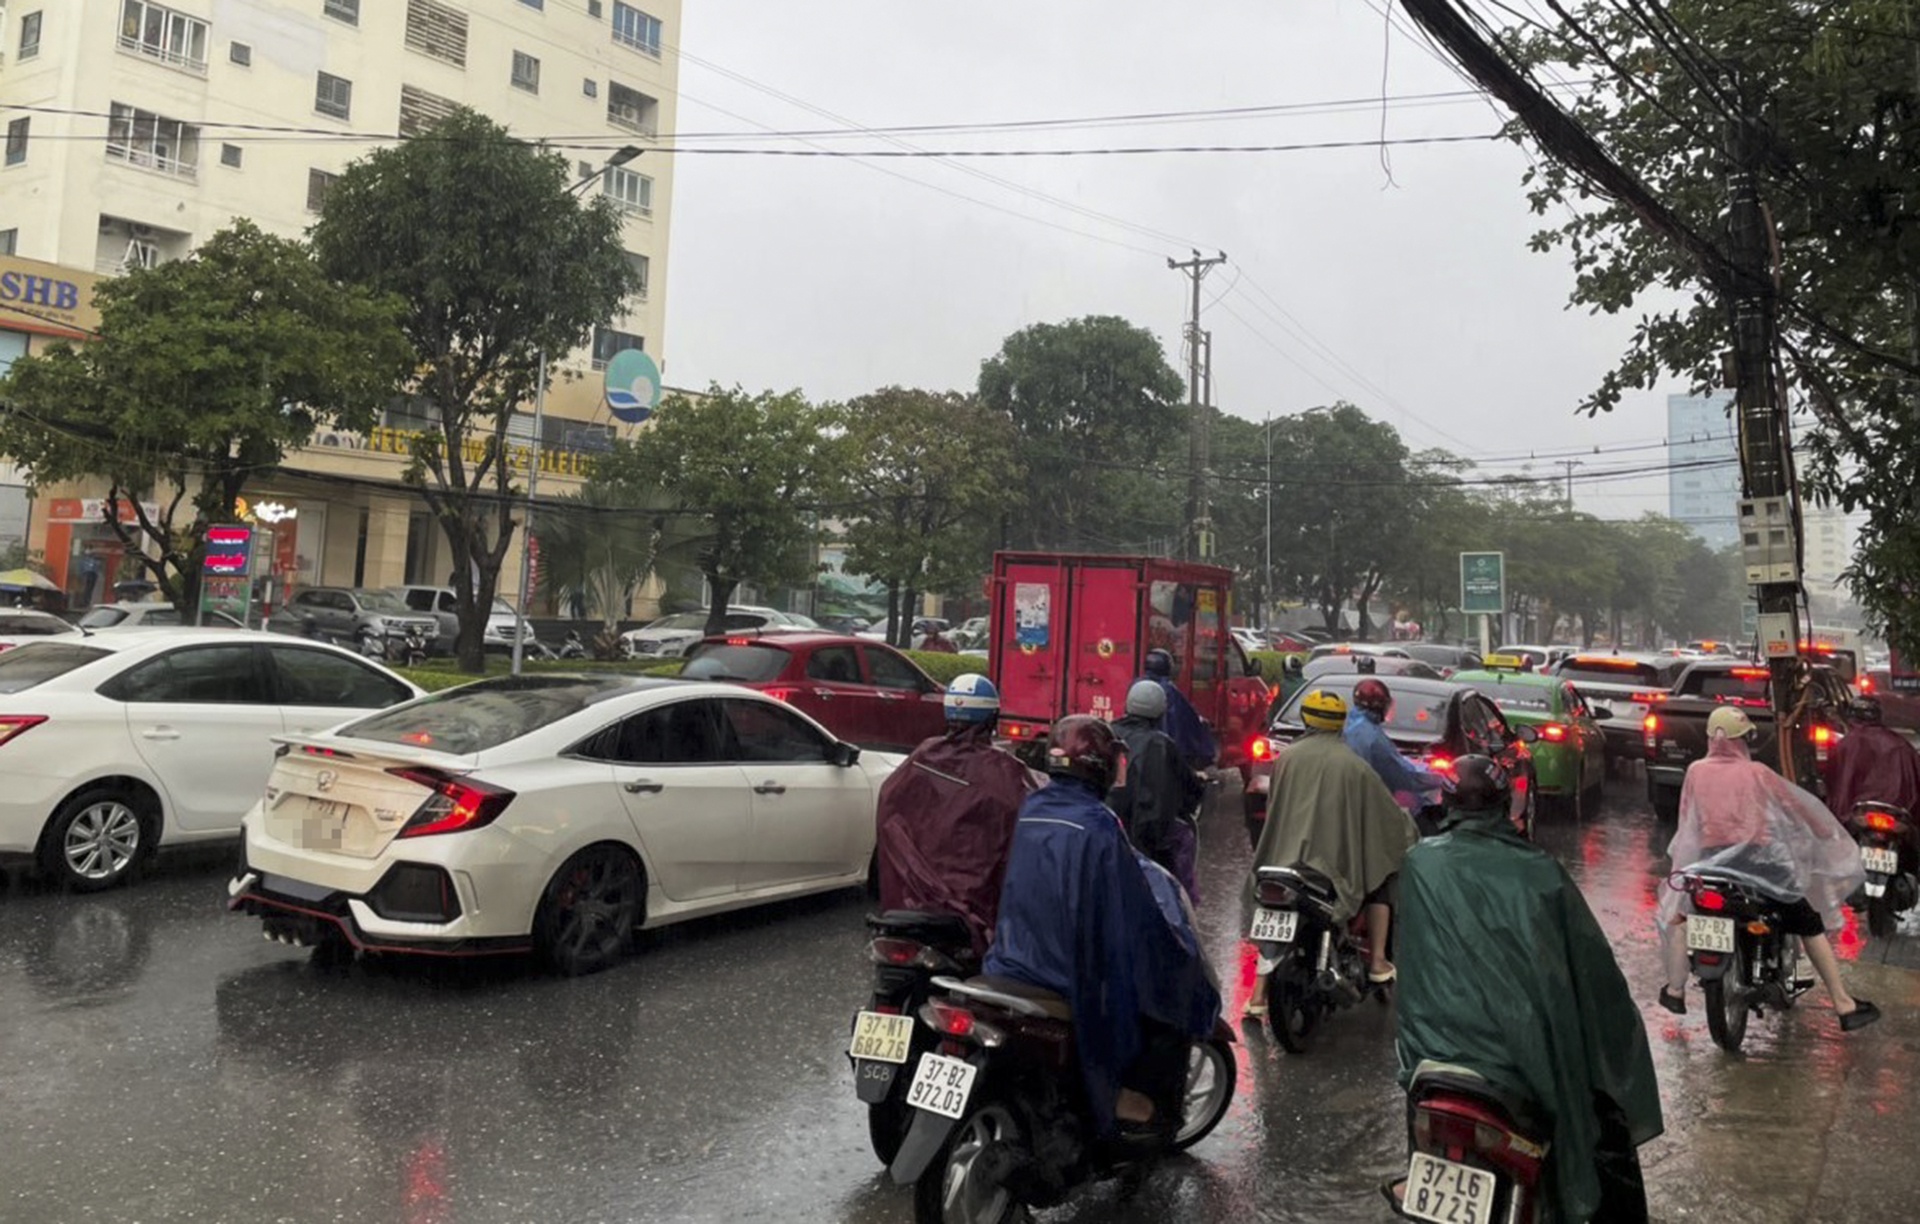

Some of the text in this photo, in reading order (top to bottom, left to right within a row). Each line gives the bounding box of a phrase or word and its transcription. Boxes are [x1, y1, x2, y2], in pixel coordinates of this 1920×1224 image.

[1, 270, 79, 310] SHB
[1694, 918, 1727, 935] 37-B2
[854, 1037, 905, 1060] 682.76
[925, 1060, 967, 1089] 37-B2
[912, 1081, 964, 1114] 972.03
[1422, 1160, 1481, 1198] 37-L6
